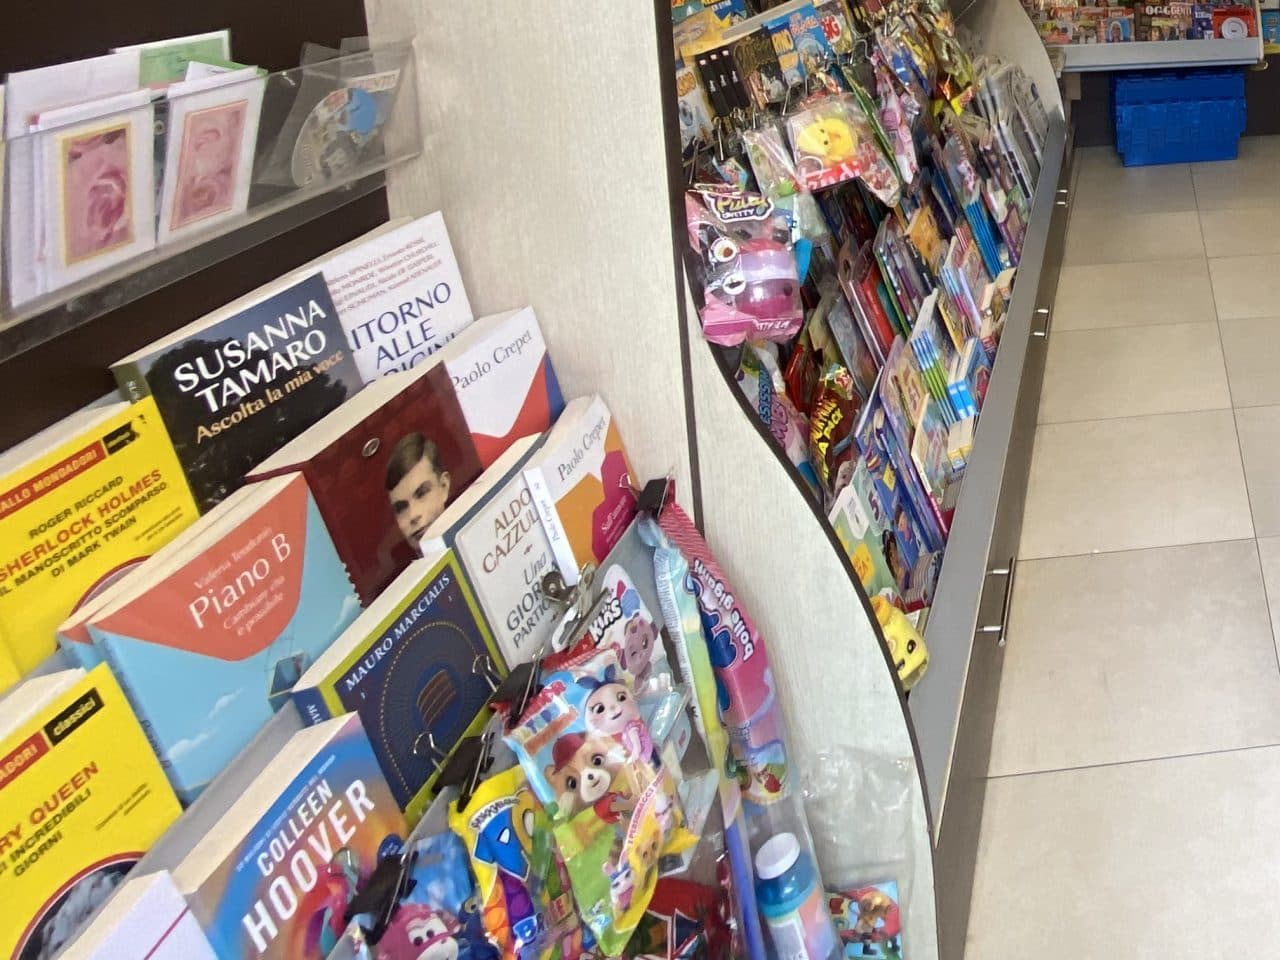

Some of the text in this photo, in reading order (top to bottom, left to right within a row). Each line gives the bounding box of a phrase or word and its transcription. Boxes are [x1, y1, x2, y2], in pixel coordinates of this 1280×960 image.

[173, 300, 328, 393] SUSANNA
[350, 282, 451, 352] ITORNO
[377, 318, 437, 370] ALLE
[195, 330, 327, 414] TAMARO
[450, 362, 491, 389] Paolo
[493, 330, 533, 364] Crepet
[196, 396, 266, 444] Ascolta
[267, 385, 283, 406] la
[285, 370, 314, 398] mia
[312, 350, 345, 381] voce
[558, 445, 584, 482] Paolo
[0, 514, 94, 583] SHERLOCK
[98, 469, 162, 521] HOLMES
[14, 525, 103, 586] MANOSCRITTO
[104, 482, 168, 529] SCOMPARSO
[28, 476, 124, 539] ROGER RICCARD
[493, 487, 532, 537] ALDO
[51, 562, 65, 578] DI
[67, 540, 101, 568] MARK
[101, 518, 137, 546] TWAIN
[188, 558, 271, 629] Piano
[272, 532, 291, 563] B
[345, 573, 452, 691] MAURO MARCIALIS
[730, 609, 755, 661] bolle
[52, 696, 97, 736] classici
[9, 789, 92, 864] INCREDIBILI
[29, 761, 99, 824] QUEEN
[257, 779, 333, 876] COLLEEN
[13, 832, 63, 877] GIORNI
[242, 779, 376, 952] HOOVER
